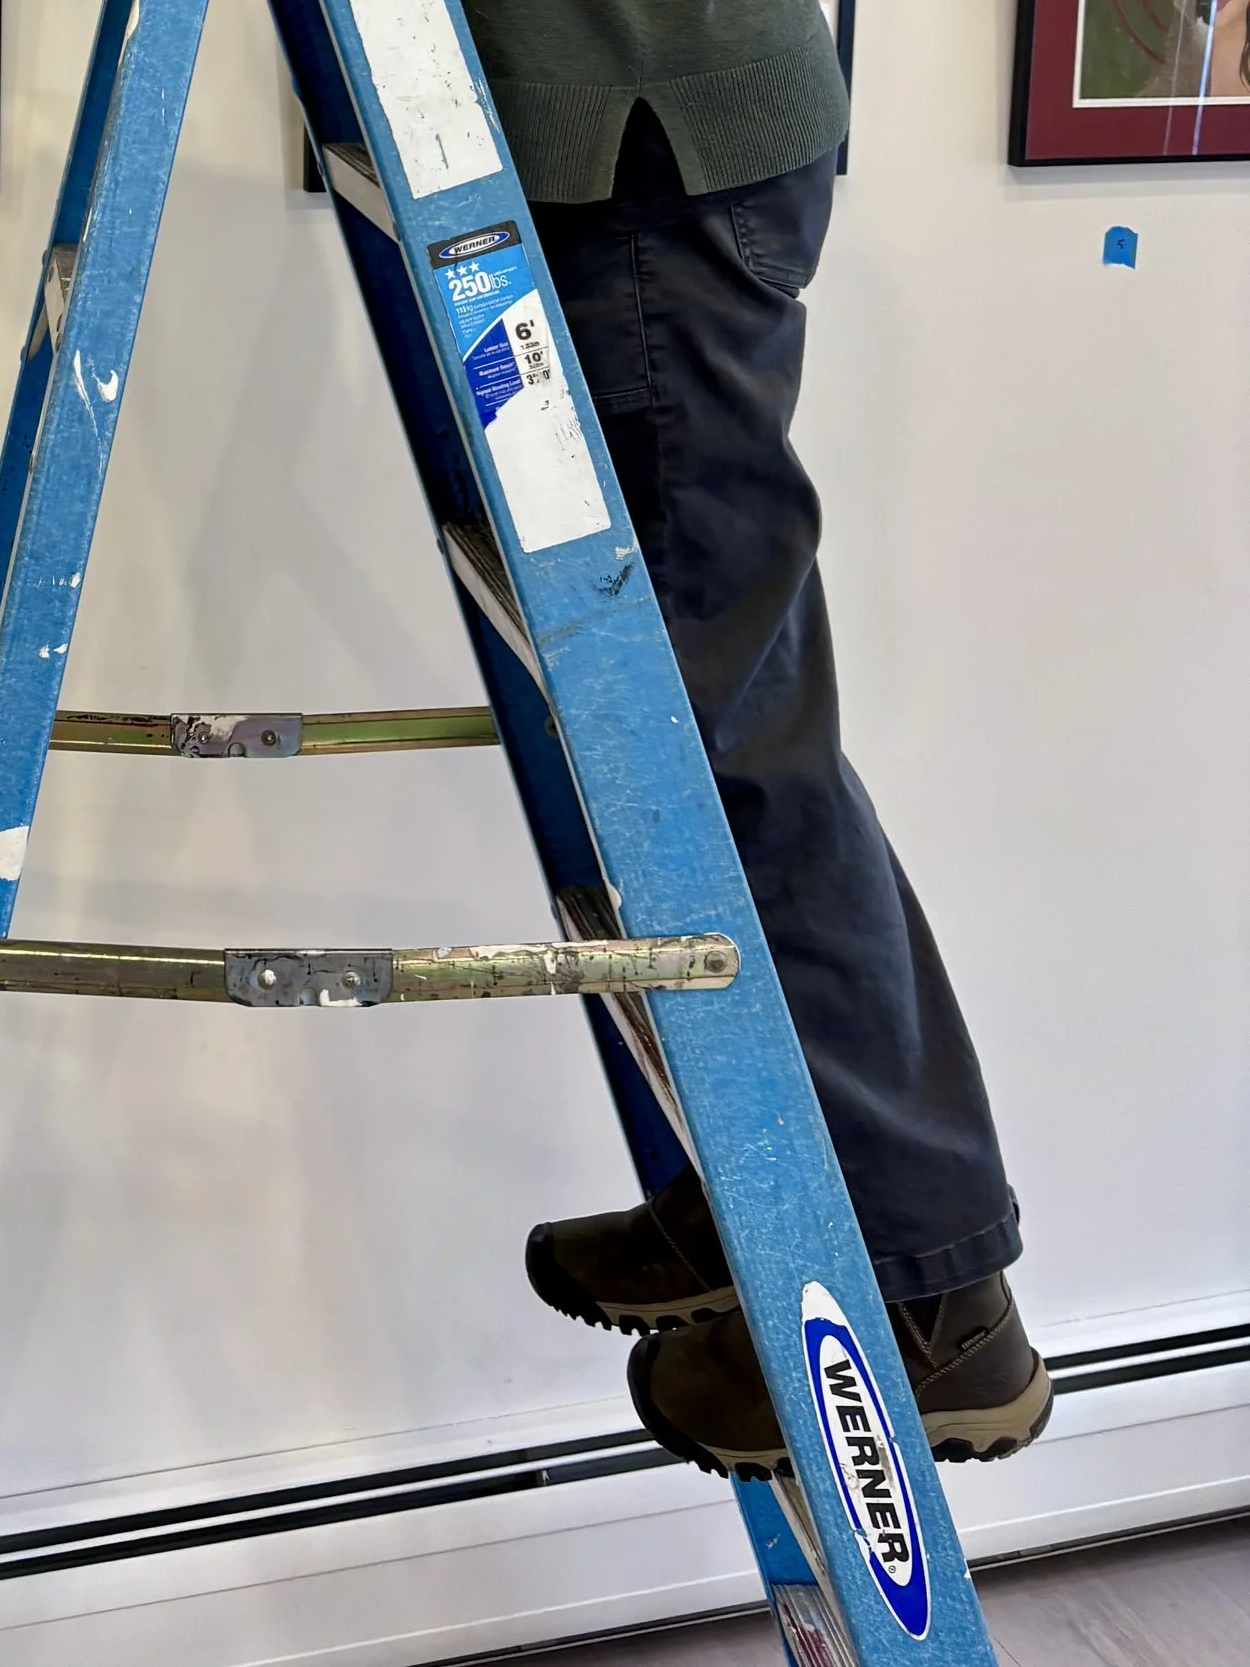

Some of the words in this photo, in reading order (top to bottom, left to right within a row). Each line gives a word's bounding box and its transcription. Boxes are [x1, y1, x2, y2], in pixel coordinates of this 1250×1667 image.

[453, 236, 496, 254] WERNER
[1116, 238, 1126, 250] 5
[515, 319, 535, 341] 6'
[524, 350, 543, 364] 10'
[824, 1359, 910, 1563] WERNER
